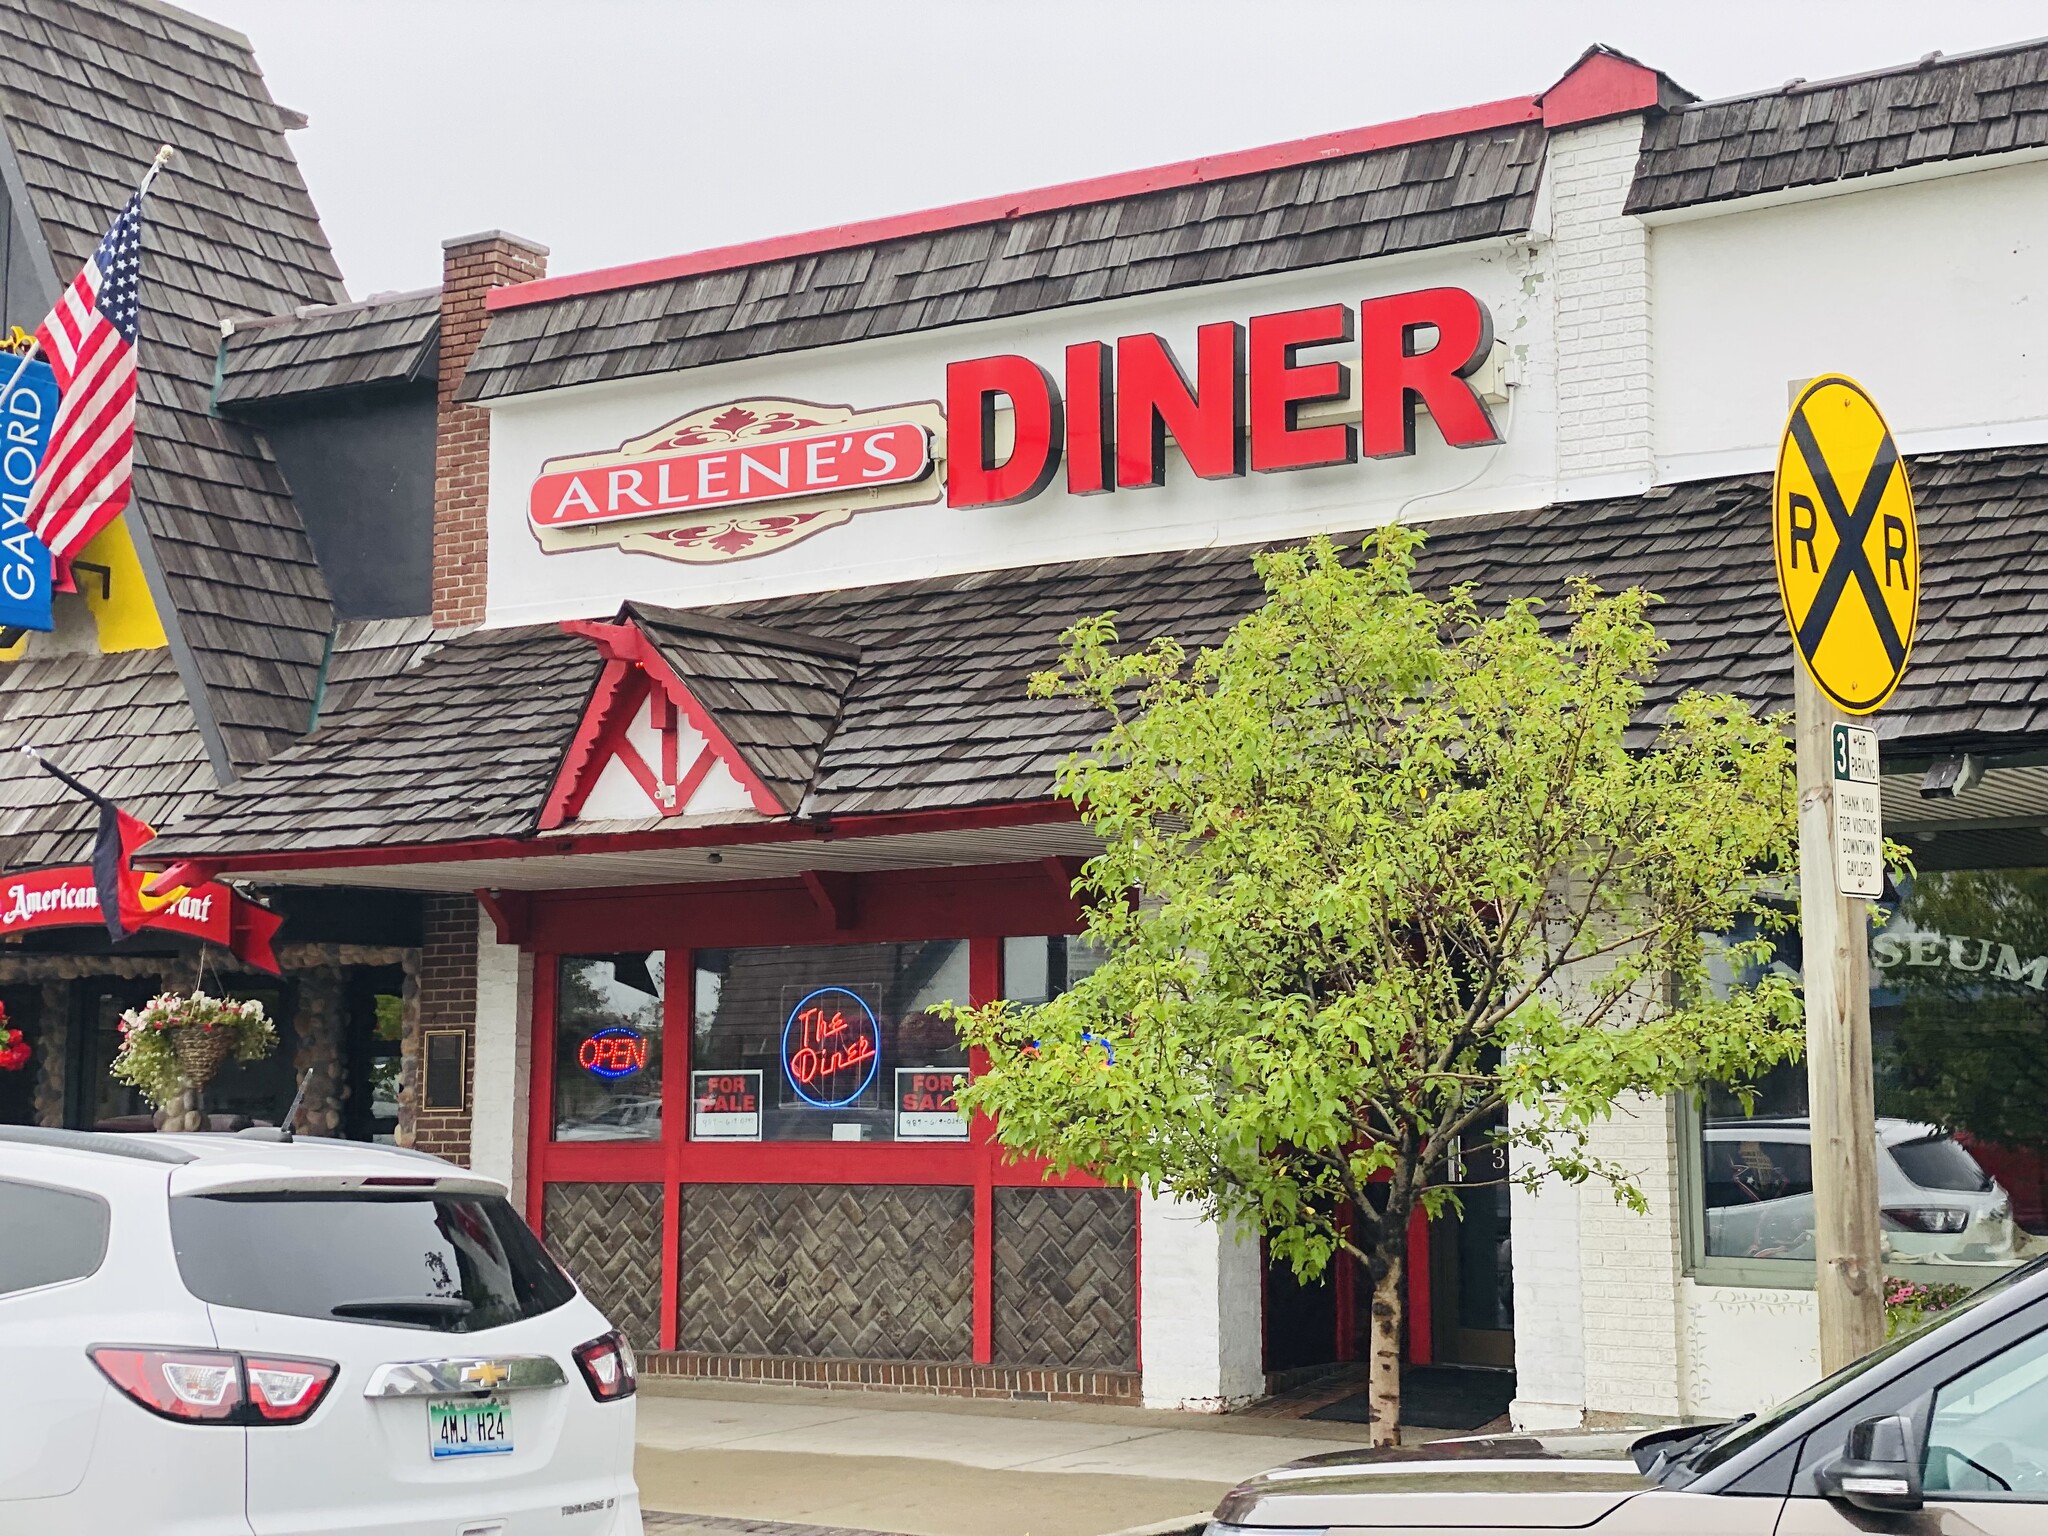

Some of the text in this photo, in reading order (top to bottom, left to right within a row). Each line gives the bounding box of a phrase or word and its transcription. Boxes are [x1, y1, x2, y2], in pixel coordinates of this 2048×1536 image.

[946, 286, 1500, 510] DINER
[553, 432, 896, 519] ARLENE'S
[1, 388, 42, 601] GAYLORD
[1789, 491, 1819, 573] R
[1884, 513, 1909, 591] R
[1836, 732, 1847, 773] 3
[1850, 756, 1876, 780] PARKING
[1841, 794, 1874, 814] THANK YOU
[1839, 815, 1877, 835] FOR VISITING
[1843, 838, 1875, 856] DOWNTOWN
[1846, 860, 1873, 877] GAYLORD
[3, 882, 99, 924] American
[798, 1007, 848, 1048] The
[579, 1038, 648, 1070] OPEN
[707, 1076, 746, 1094] FOR
[912, 1074, 953, 1092] FOR
[441, 1411, 504, 1444] 4MJ H24
